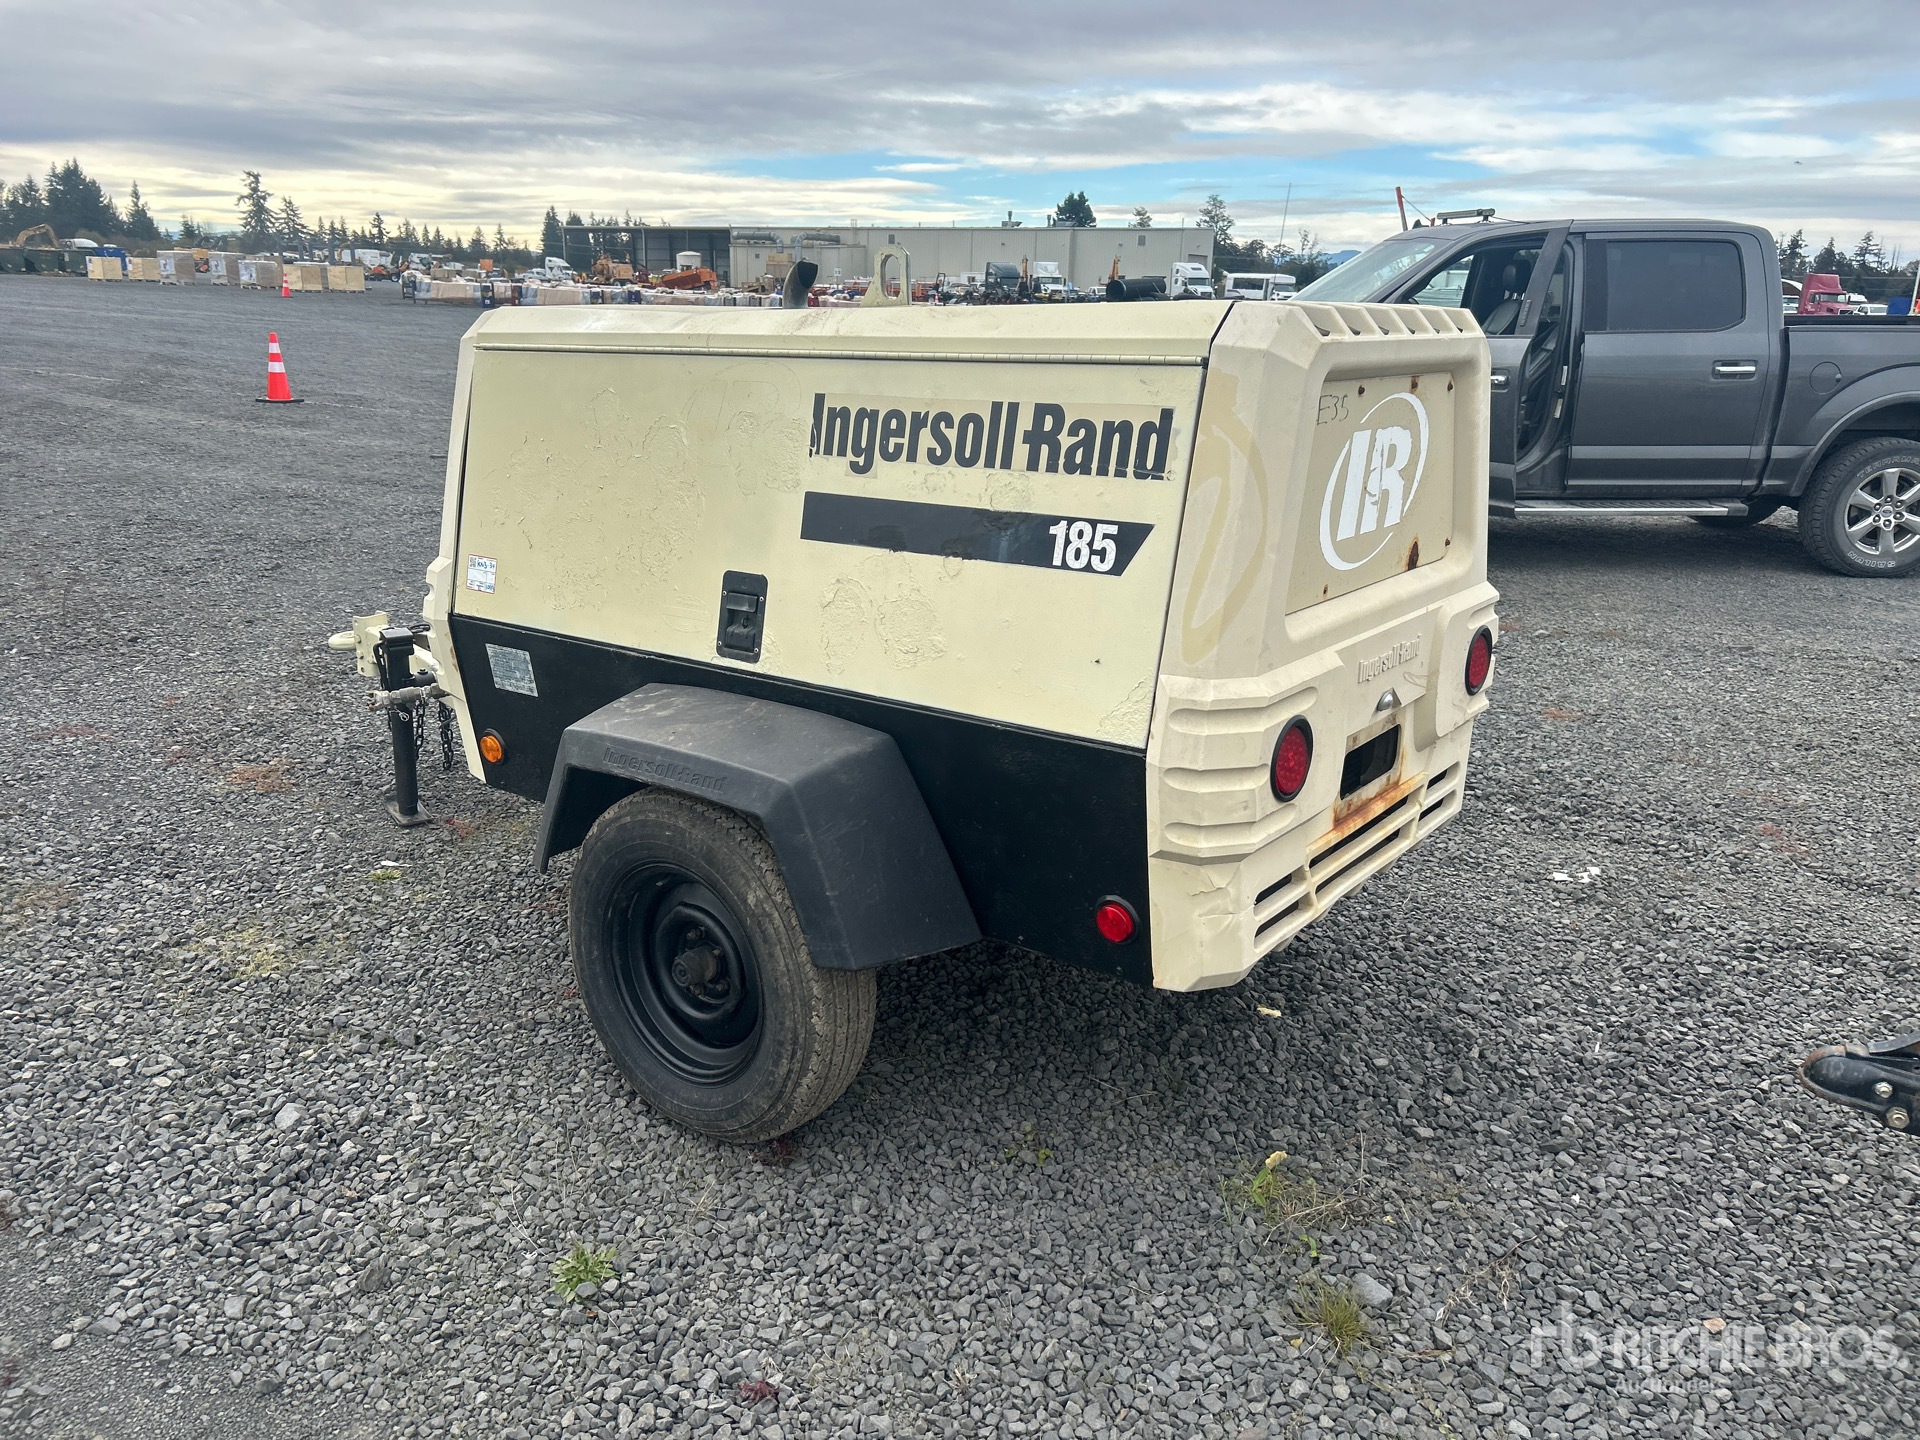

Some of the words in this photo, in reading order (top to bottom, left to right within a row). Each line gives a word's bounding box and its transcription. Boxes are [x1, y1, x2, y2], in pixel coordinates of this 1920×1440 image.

[1316, 394, 1349, 426] E35
[1336, 425, 1412, 542] IR
[1049, 520, 1118, 572] 185
[1847, 551, 1895, 568] SAILUN
